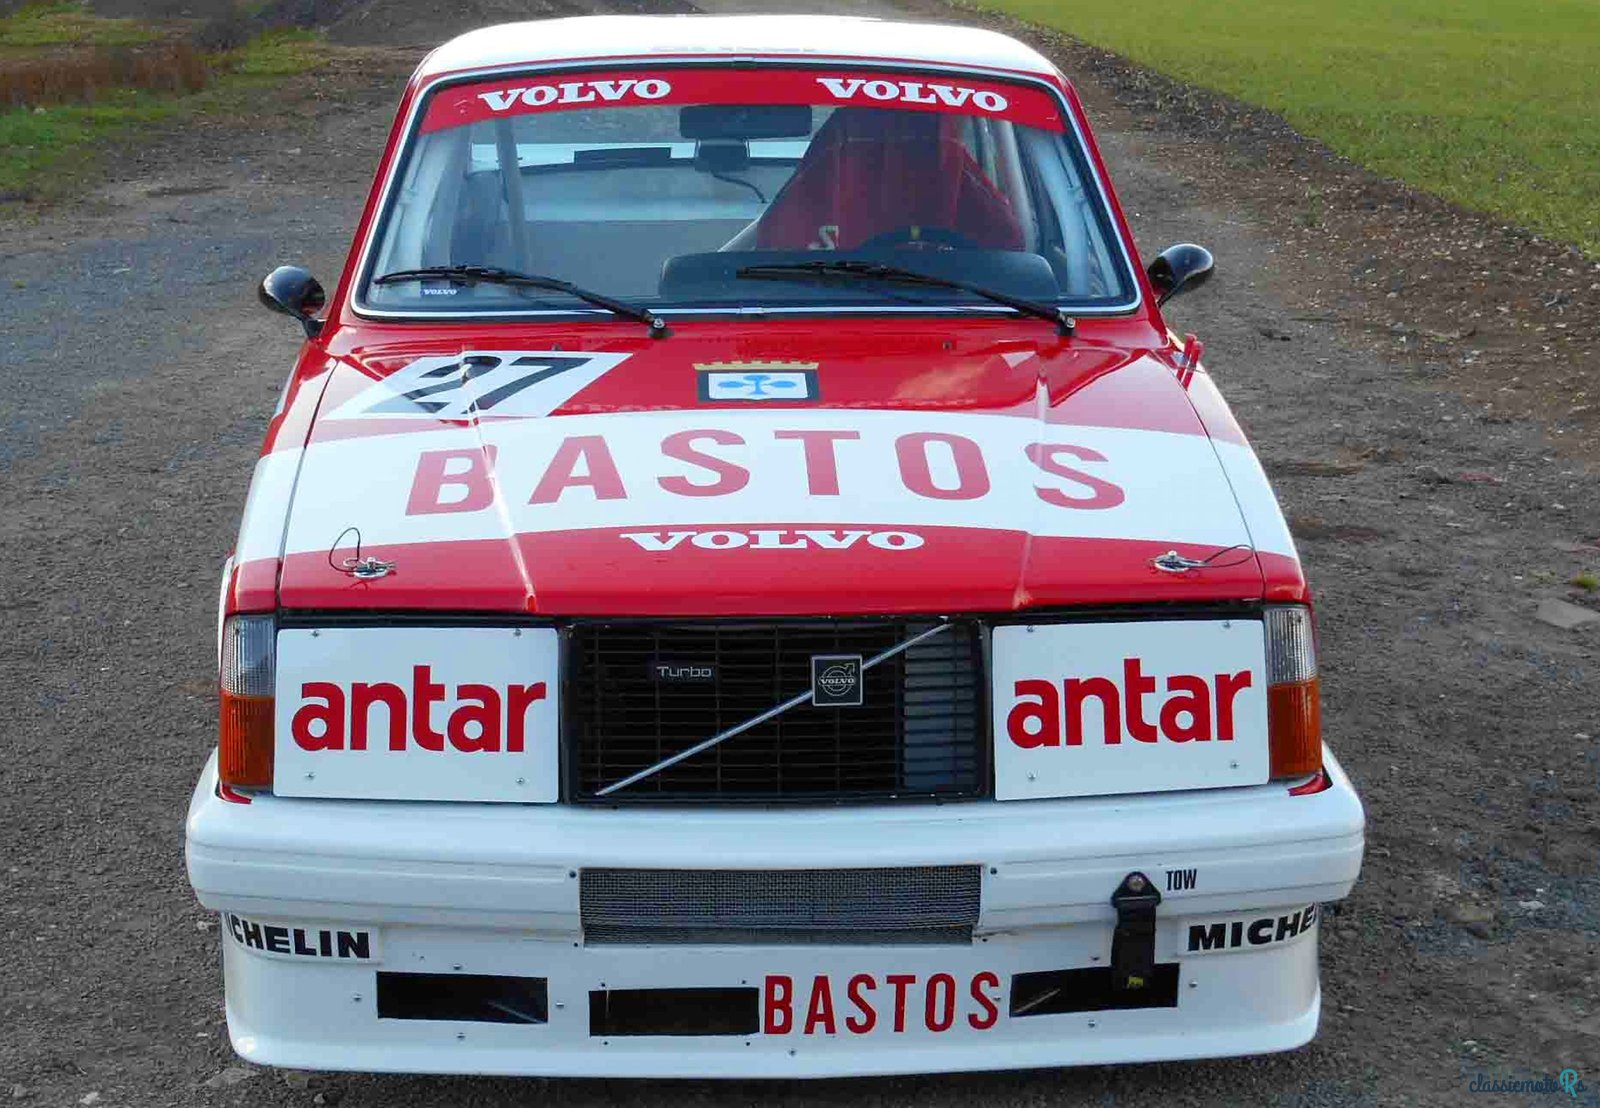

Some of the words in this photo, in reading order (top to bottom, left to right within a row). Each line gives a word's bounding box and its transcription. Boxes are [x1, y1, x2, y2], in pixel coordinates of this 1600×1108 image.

[478, 79, 671, 111] VOLVO
[816, 77, 1008, 112] VOLVO
[361, 355, 594, 414] 27
[405, 429, 1125, 515] BASTOS
[620, 530, 925, 551] VOLVO
[656, 666, 712, 678] Turbo
[291, 664, 547, 753] antar
[1006, 658, 1252, 749] antar
[1166, 869, 1197, 891] TOW
[764, 971, 999, 1034] BASTOS
